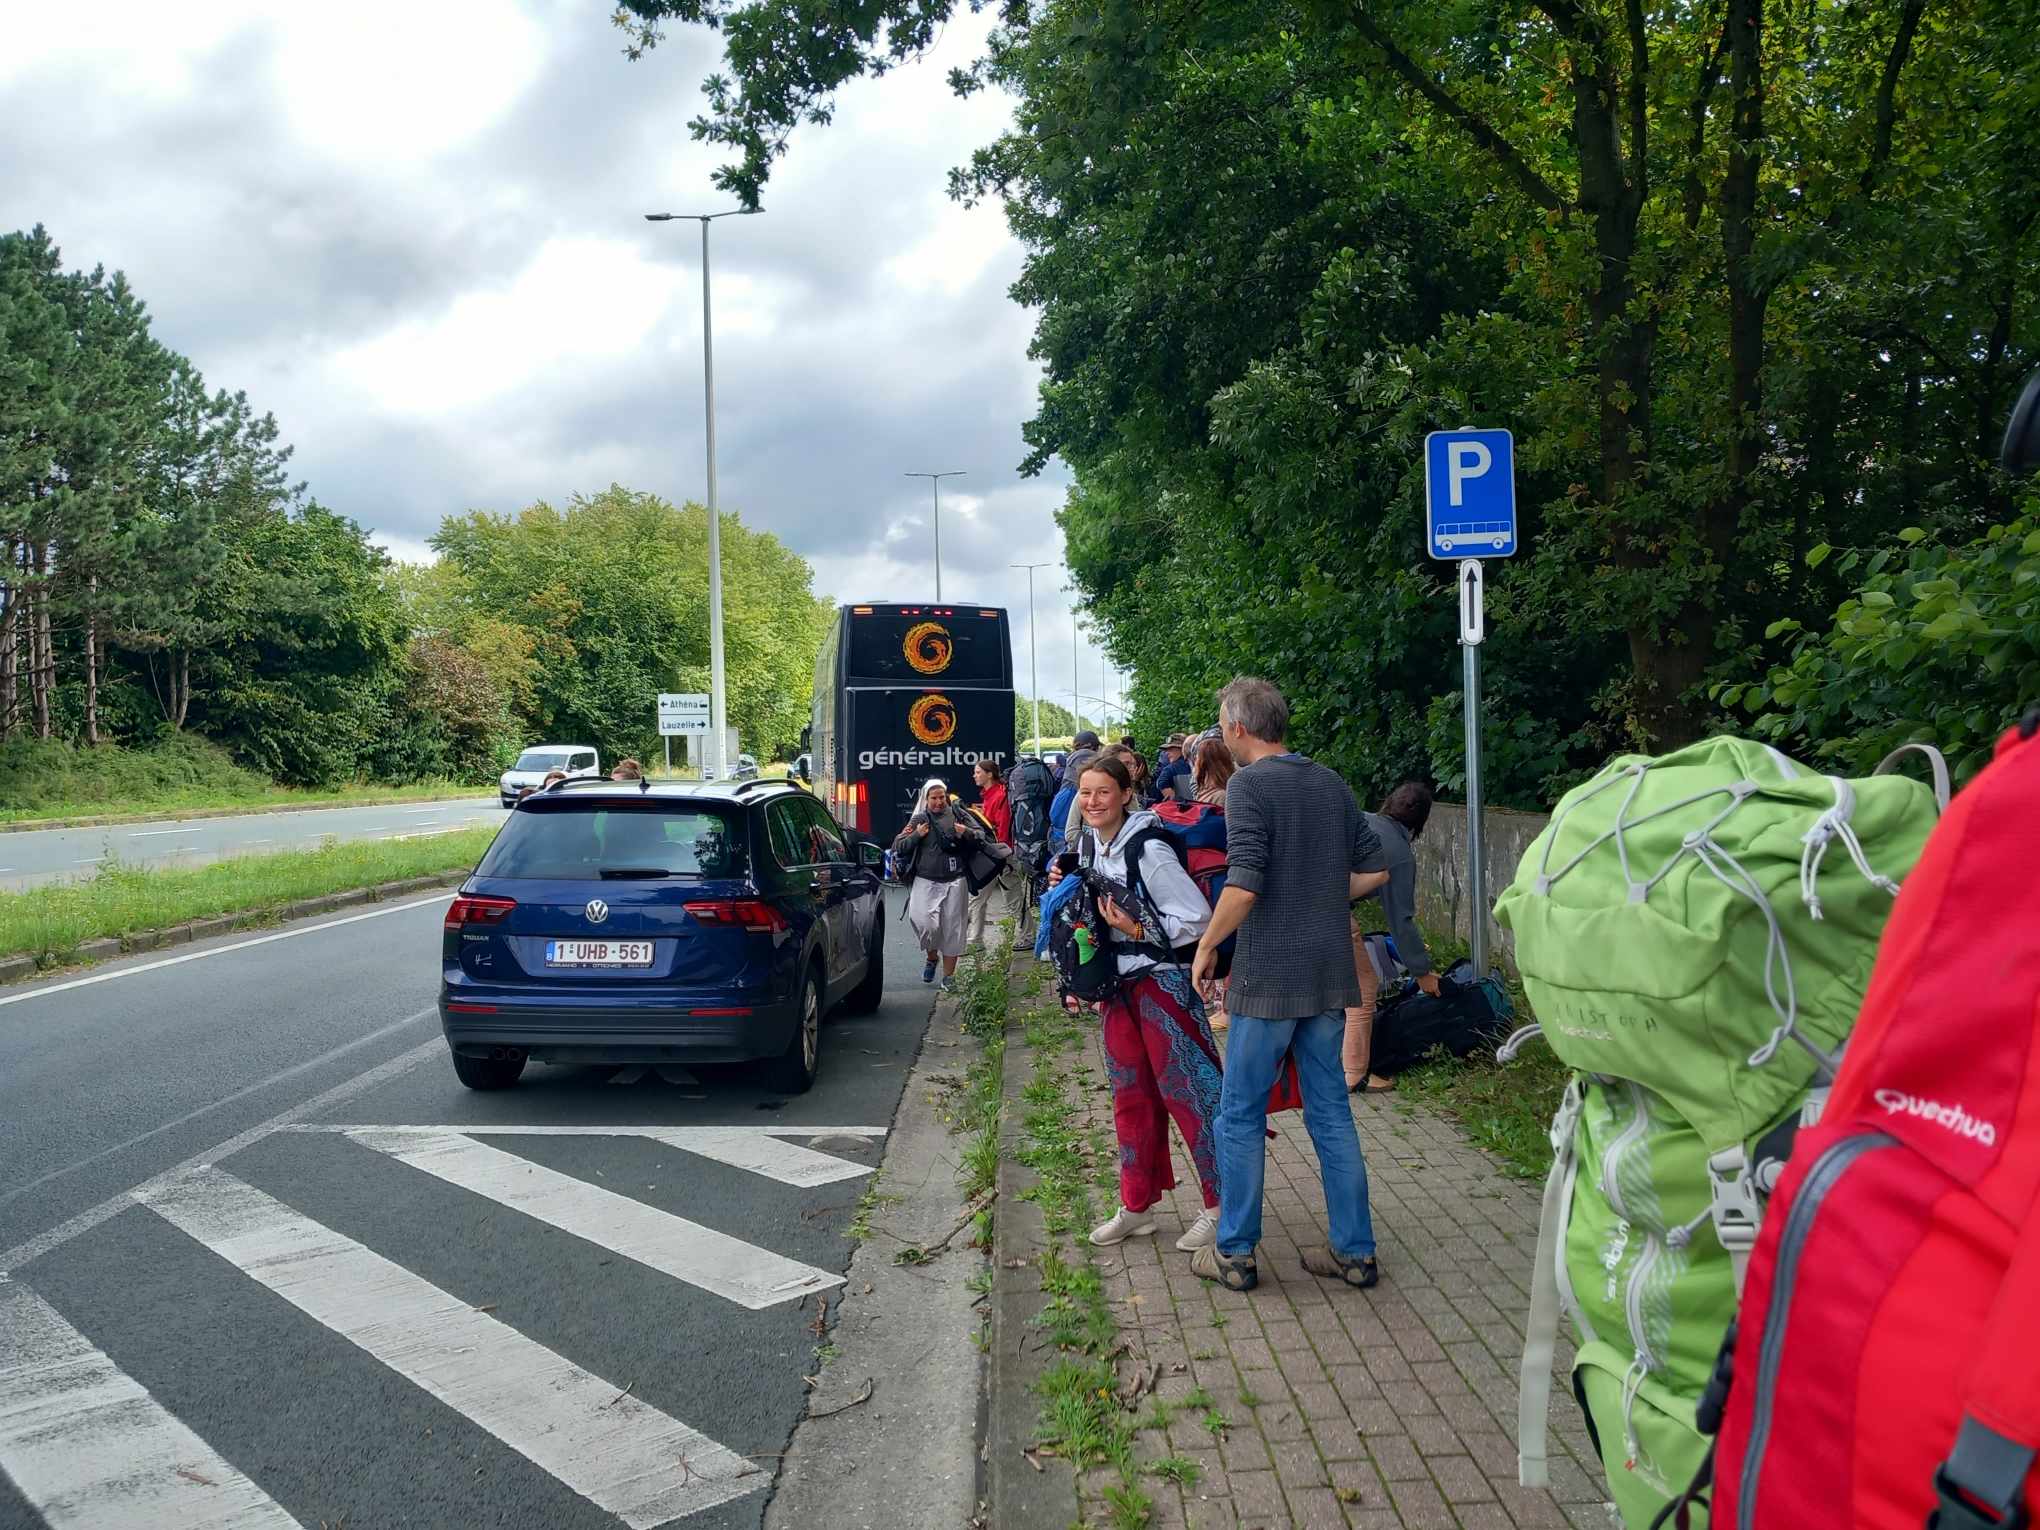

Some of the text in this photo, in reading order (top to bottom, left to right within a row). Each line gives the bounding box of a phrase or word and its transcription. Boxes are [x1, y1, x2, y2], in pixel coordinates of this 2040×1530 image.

[1447, 441, 1492, 507] P
[858, 746, 1006, 770] généraltour
[1873, 1087, 1996, 1147] Quechua
